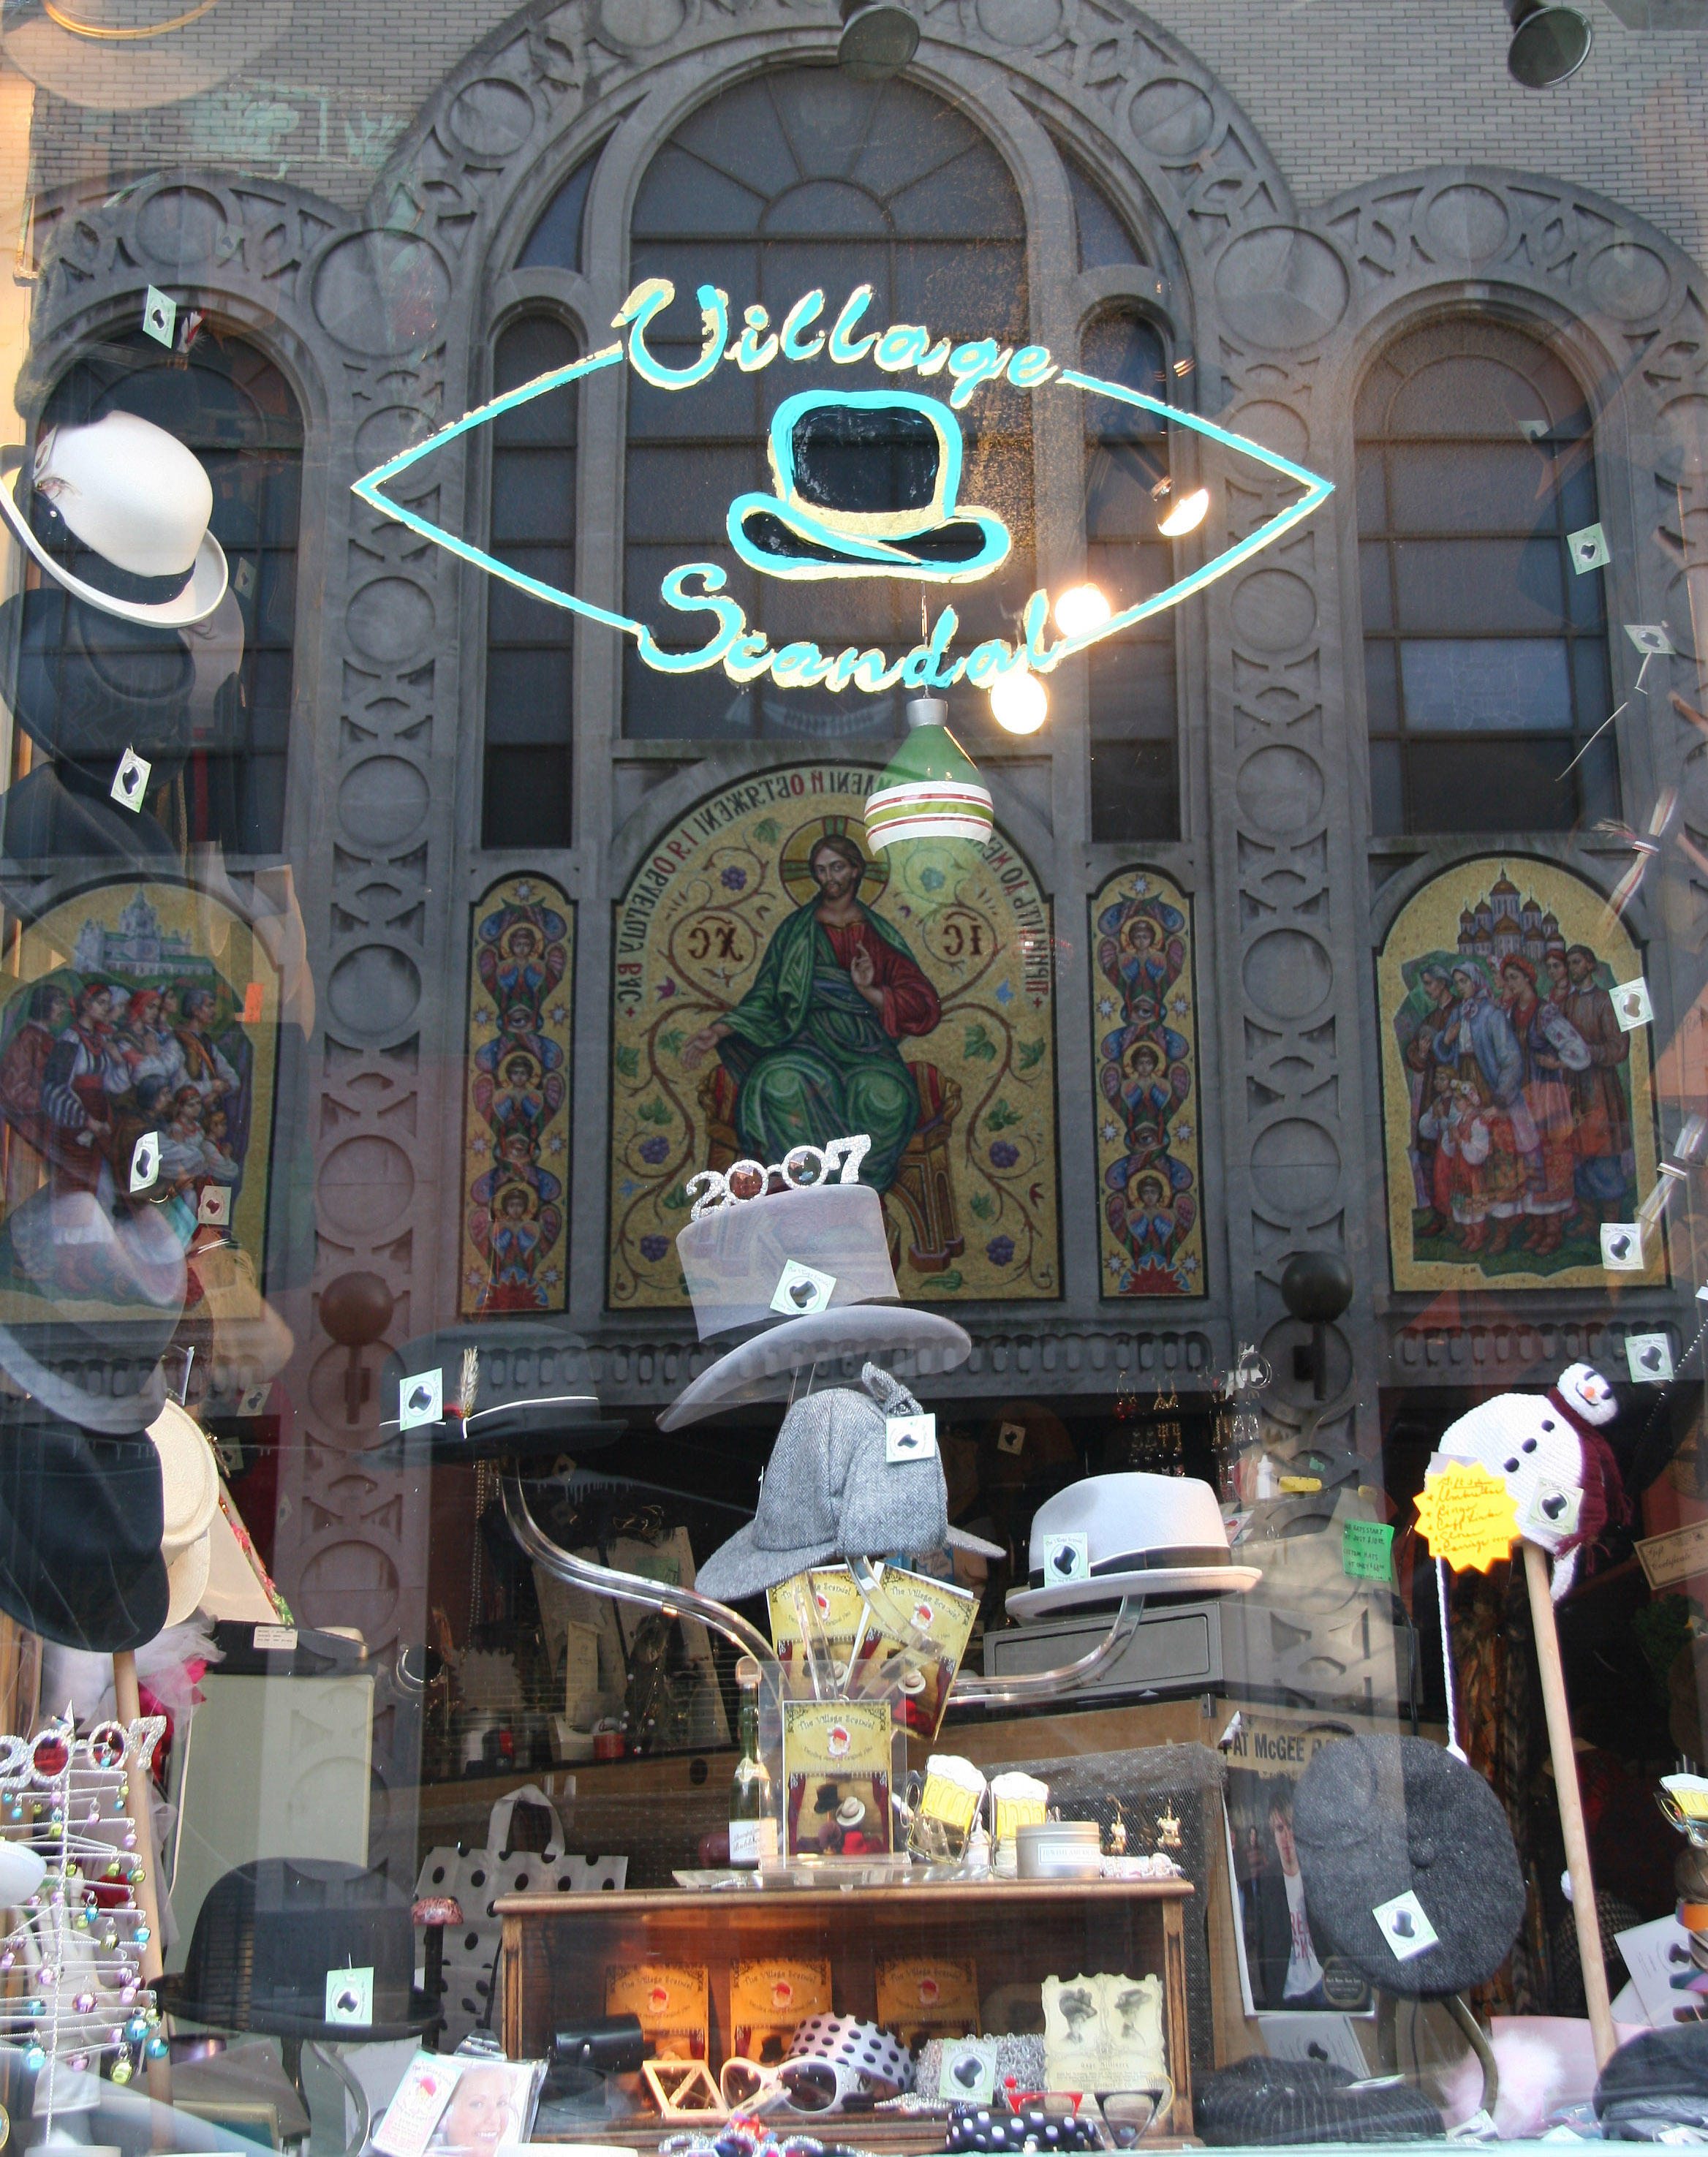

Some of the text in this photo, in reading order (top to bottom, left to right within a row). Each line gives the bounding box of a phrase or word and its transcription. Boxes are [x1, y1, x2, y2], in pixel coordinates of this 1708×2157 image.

[611, 278, 1058, 409] Village
[636, 562, 1062, 694] Scandal
[686, 1133, 872, 1222] 2007
[891, 1585, 905, 1596] The
[908, 1587, 933, 1603] Village
[798, 1720, 814, 1731] The
[817, 1713, 842, 1724] Village
[1253, 1732, 1306, 1761] McGEE
